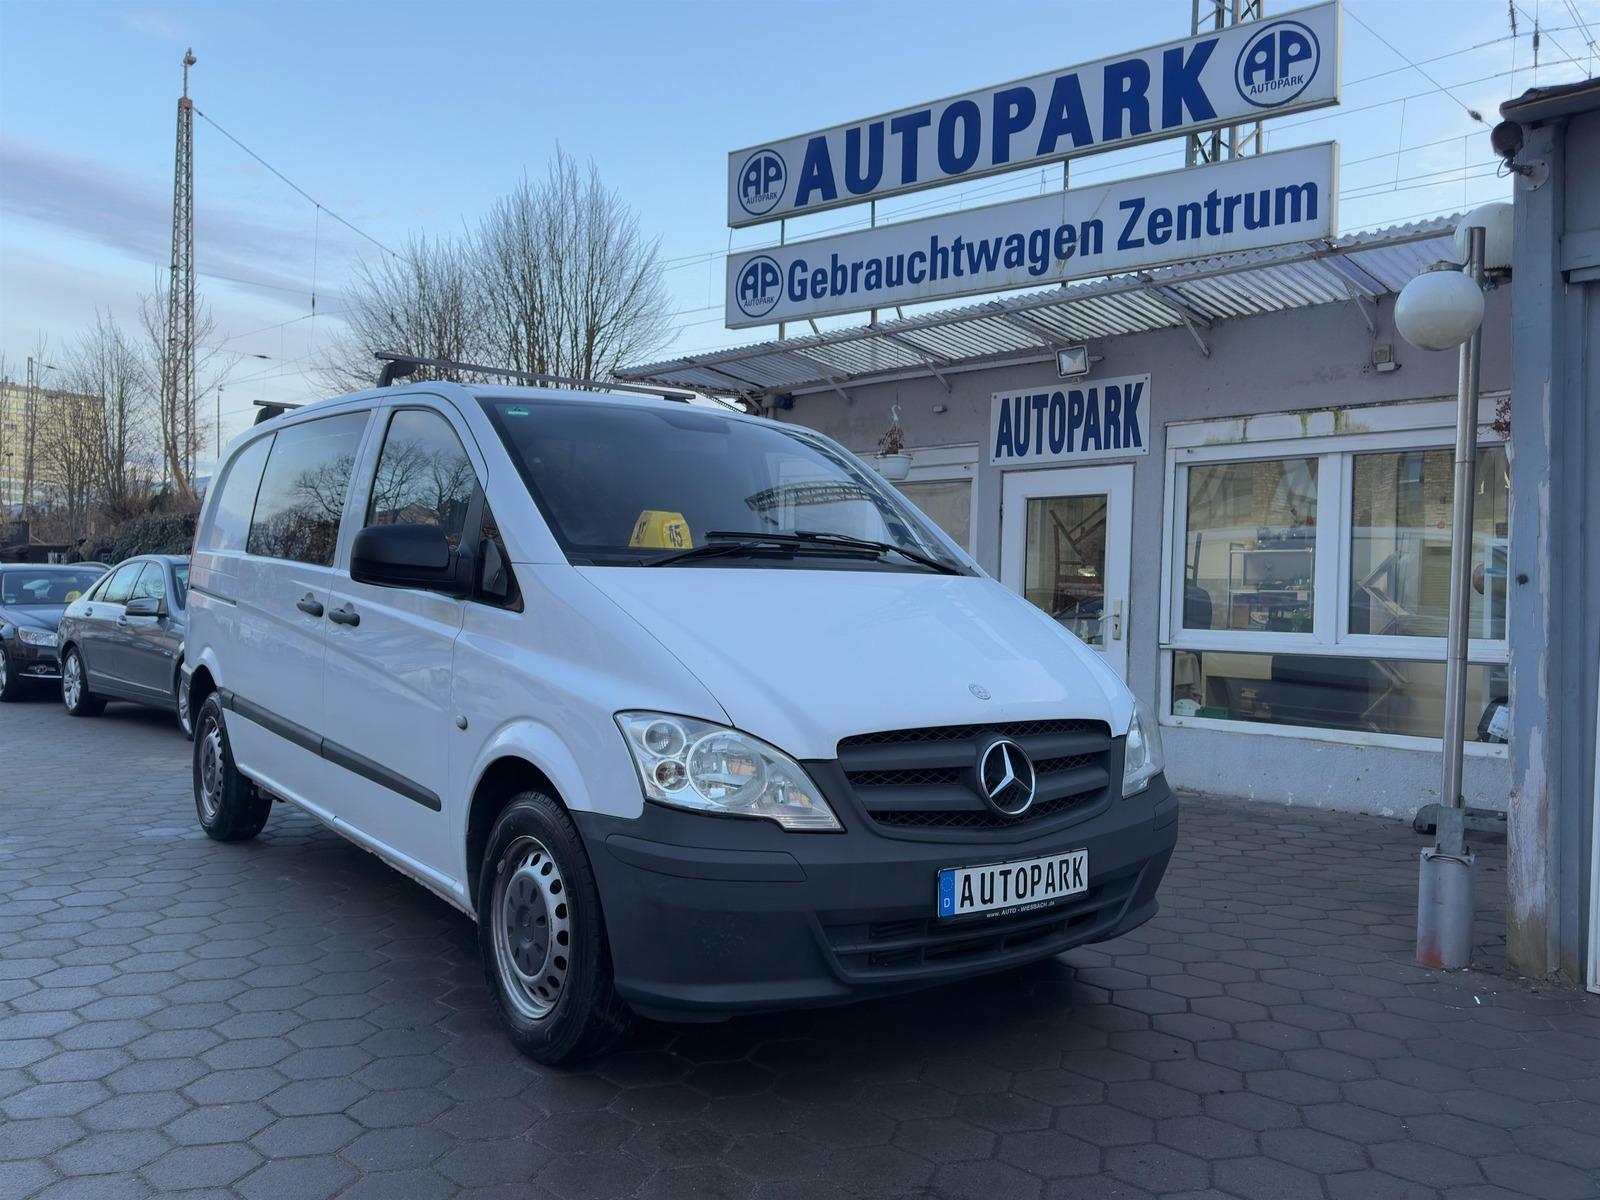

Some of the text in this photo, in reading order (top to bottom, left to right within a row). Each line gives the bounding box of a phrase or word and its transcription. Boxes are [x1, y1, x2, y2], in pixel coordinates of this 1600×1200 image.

[1243, 30, 1313, 87] AP
[1249, 74, 1304, 96] AUTOPARK
[793, 38, 1220, 208] AUTOPARK
[742, 156, 783, 198] AP
[746, 191, 778, 206] AUTOPARK
[787, 181, 1319, 303] Gebrauchtwagen Zentrum
[740, 261, 780, 301] AP
[743, 295, 775, 308] AUTOPARK
[995, 381, 1145, 458] AUTOPARK
[943, 855, 1084, 908] D AUTOPARK
